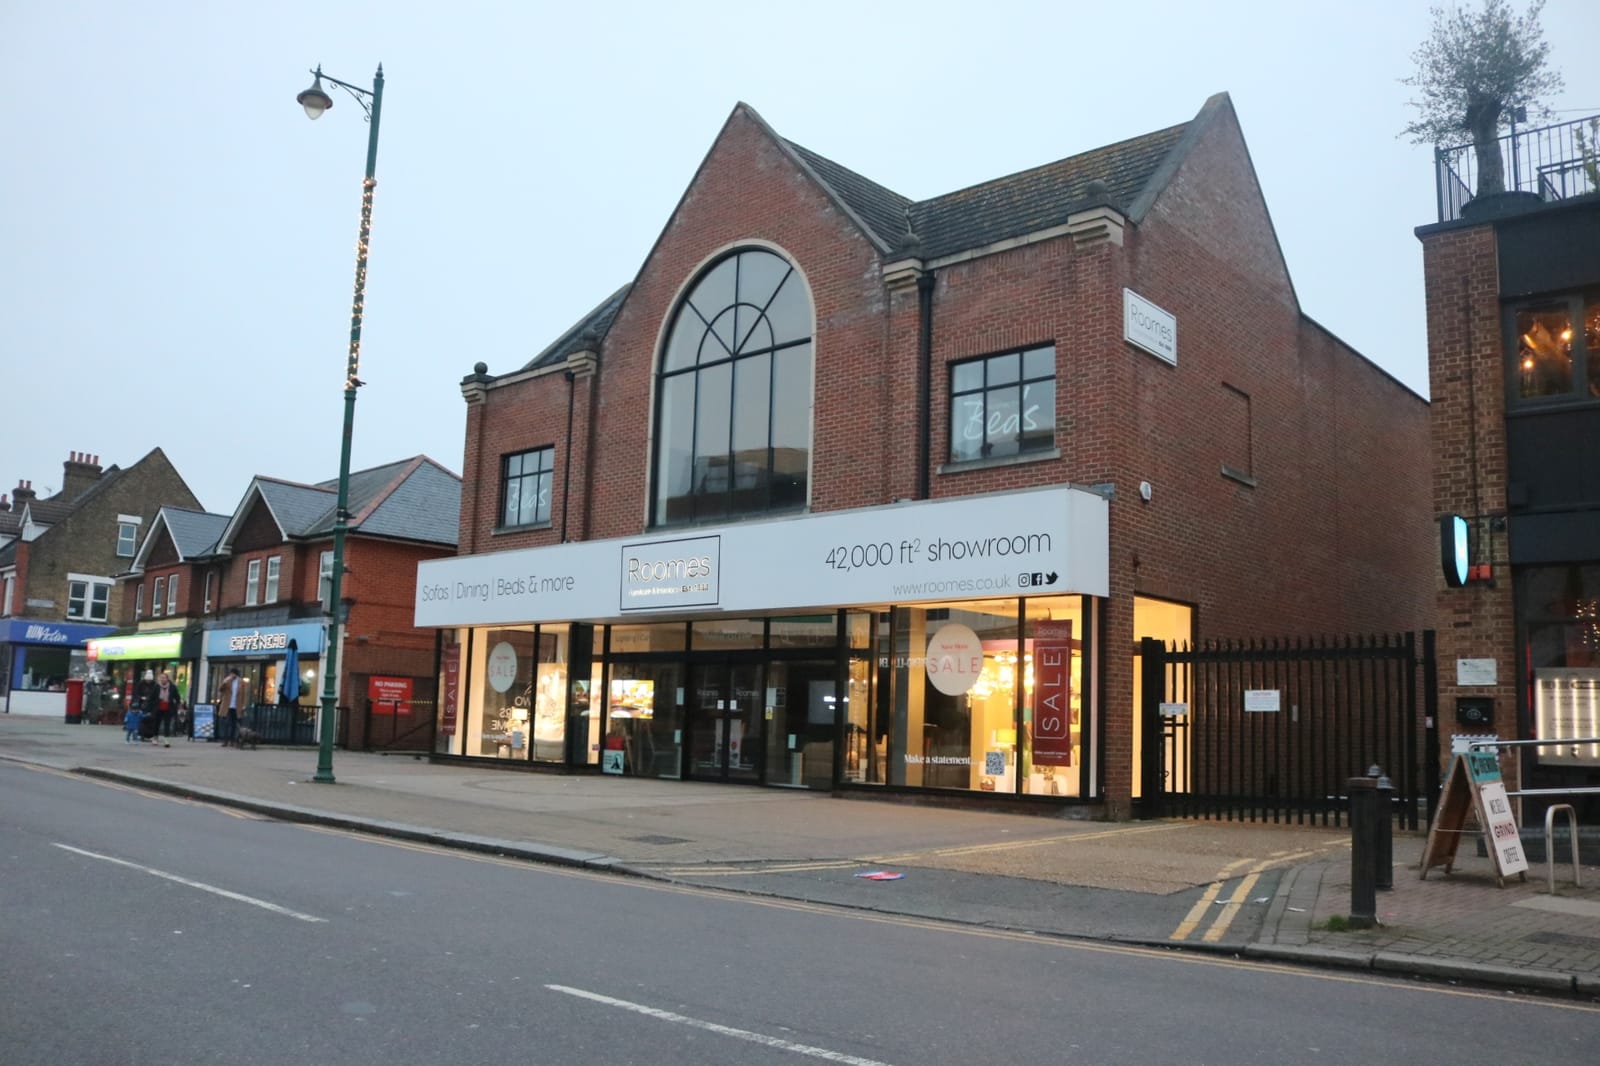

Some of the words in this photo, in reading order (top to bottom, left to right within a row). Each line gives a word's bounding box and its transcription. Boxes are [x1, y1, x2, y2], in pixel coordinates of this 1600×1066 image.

[1131, 303, 1173, 343] Roomes
[825, 542, 893, 572] 42,000
[927, 533, 1051, 562] showroom
[628, 556, 710, 584] Roomes
[422, 584, 449, 602] Sofas
[456, 581, 489, 601] Dining
[497, 578, 525, 596] Beds
[527, 576, 539, 594] &
[540, 575, 575, 593] more
[893, 574, 1011, 596] www.roomes.co.uk
[929, 655, 979, 674] SALE
[447, 663, 457, 714] SALE
[1042, 652, 1062, 732] SALE
[904, 753, 925, 764] Make
[925, 756, 931, 764] a
[1494, 822, 1515, 838] GRIND
